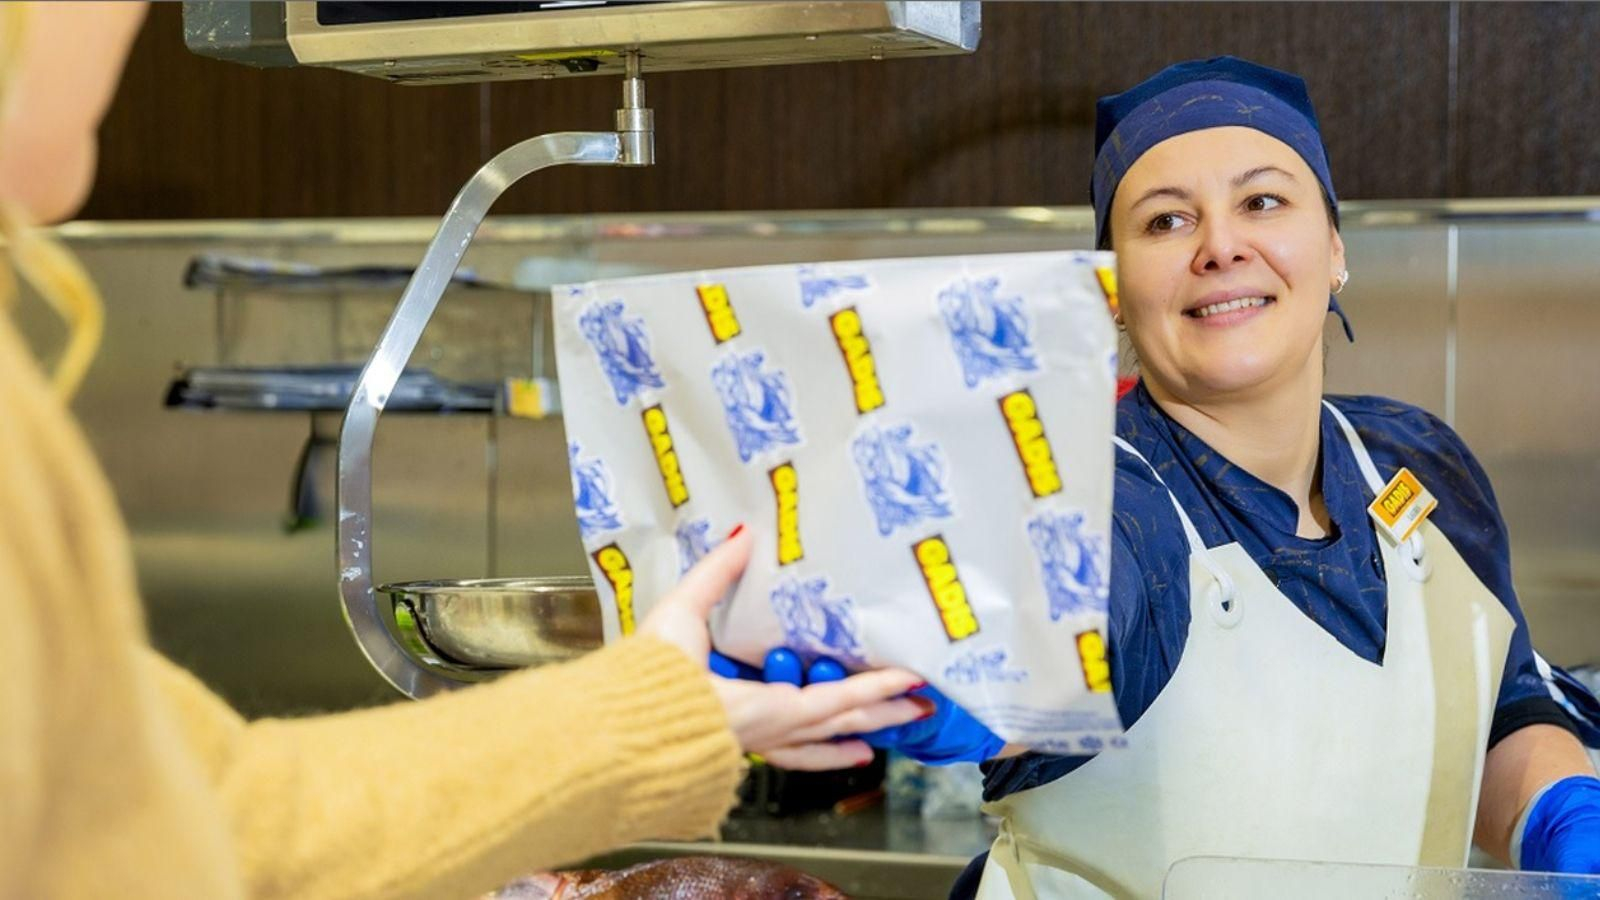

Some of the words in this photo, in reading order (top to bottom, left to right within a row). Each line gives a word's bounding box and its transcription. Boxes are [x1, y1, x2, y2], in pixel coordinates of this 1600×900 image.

[834, 308, 884, 413] GADIS
[642, 406, 688, 506] GADIS
[1002, 391, 1061, 497] GADIS
[774, 464, 803, 565] GADIS
[1382, 482, 1411, 514] GADIS
[916, 538, 977, 639] GADIS
